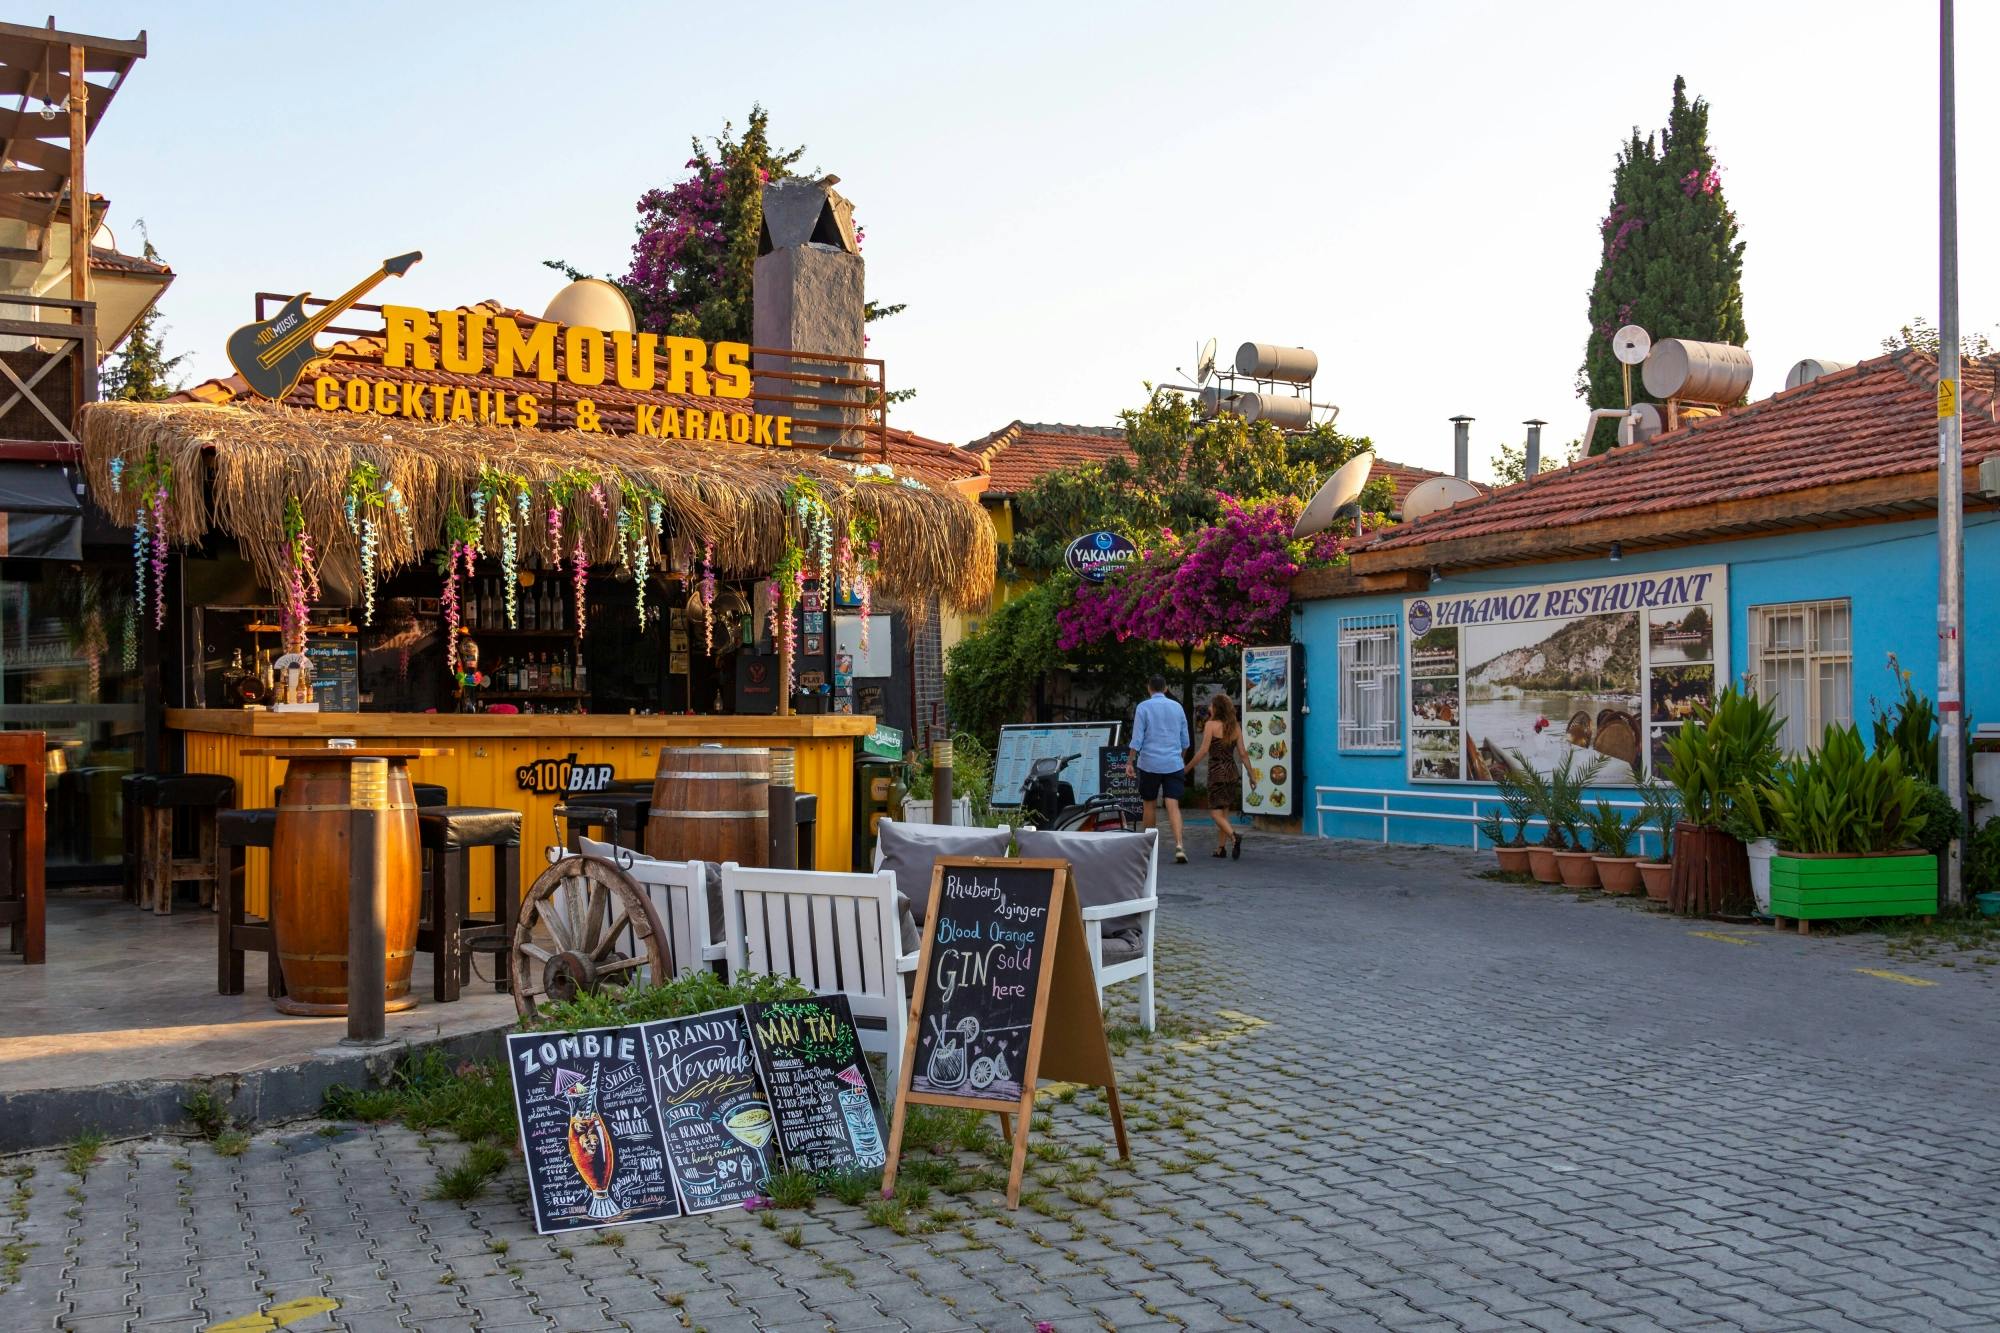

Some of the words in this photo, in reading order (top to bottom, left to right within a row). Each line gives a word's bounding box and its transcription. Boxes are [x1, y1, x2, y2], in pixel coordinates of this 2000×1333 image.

[381, 304, 751, 399] RUMOURS
[315, 376, 539, 427] COCKTAILS
[576, 399, 603, 432] &
[635, 404, 793, 446] KARAOKE
[1075, 549, 1134, 562] YAKAMOZ
[1437, 592, 1541, 626] YAKAMOZ
[1544, 573, 1712, 618] RESTAURANT
[946, 876, 1001, 899] Rhubarb
[1004, 905, 1046, 923] ginger
[937, 917, 981, 944] Blood
[989, 921, 1036, 950] Orange
[936, 944, 1006, 1003] GIN
[996, 948, 1032, 971] sold
[992, 978, 1025, 1000] here
[652, 1019, 738, 1060] BRANDY
[755, 1016, 800, 1050] MAI
[803, 1014, 838, 1042] TAI
[518, 1034, 636, 1076] ZOMBIE
[605, 1065, 636, 1090] SHAKE
[776, 1071, 790, 1084] TBSP
[793, 1069, 815, 1082] White
[814, 1066, 835, 1080] Rum
[736, 1092, 751, 1101] WITH
[779, 1085, 793, 1097] TBSP
[794, 1080, 816, 1096] Dark
[815, 1079, 839, 1095] Rum
[783, 1098, 797, 1109] TBSP
[786, 1110, 803, 1119] TBSP
[816, 1104, 833, 1114] TBSP
[616, 1108, 630, 1121] IN
[633, 1105, 642, 1119] A
[669, 1106, 696, 1121] SHAKE
[611, 1118, 653, 1136] SHAKER
[678, 1121, 714, 1139] BRANDY
[684, 1138, 701, 1147] DARK
[784, 1127, 817, 1151] COMBINE
[816, 1127, 823, 1137] &
[823, 1122, 848, 1142] SHAKE
[640, 1156, 663, 1171] RUM
[691, 1151, 714, 1166] heavy
[714, 1145, 746, 1158] cream
[683, 1167, 700, 1179] WITH
[612, 1169, 643, 1202] garnish
[689, 1184, 714, 1195] STRAIN
[552, 1195, 576, 1205] RUM
[693, 1198, 720, 1208] chilled
